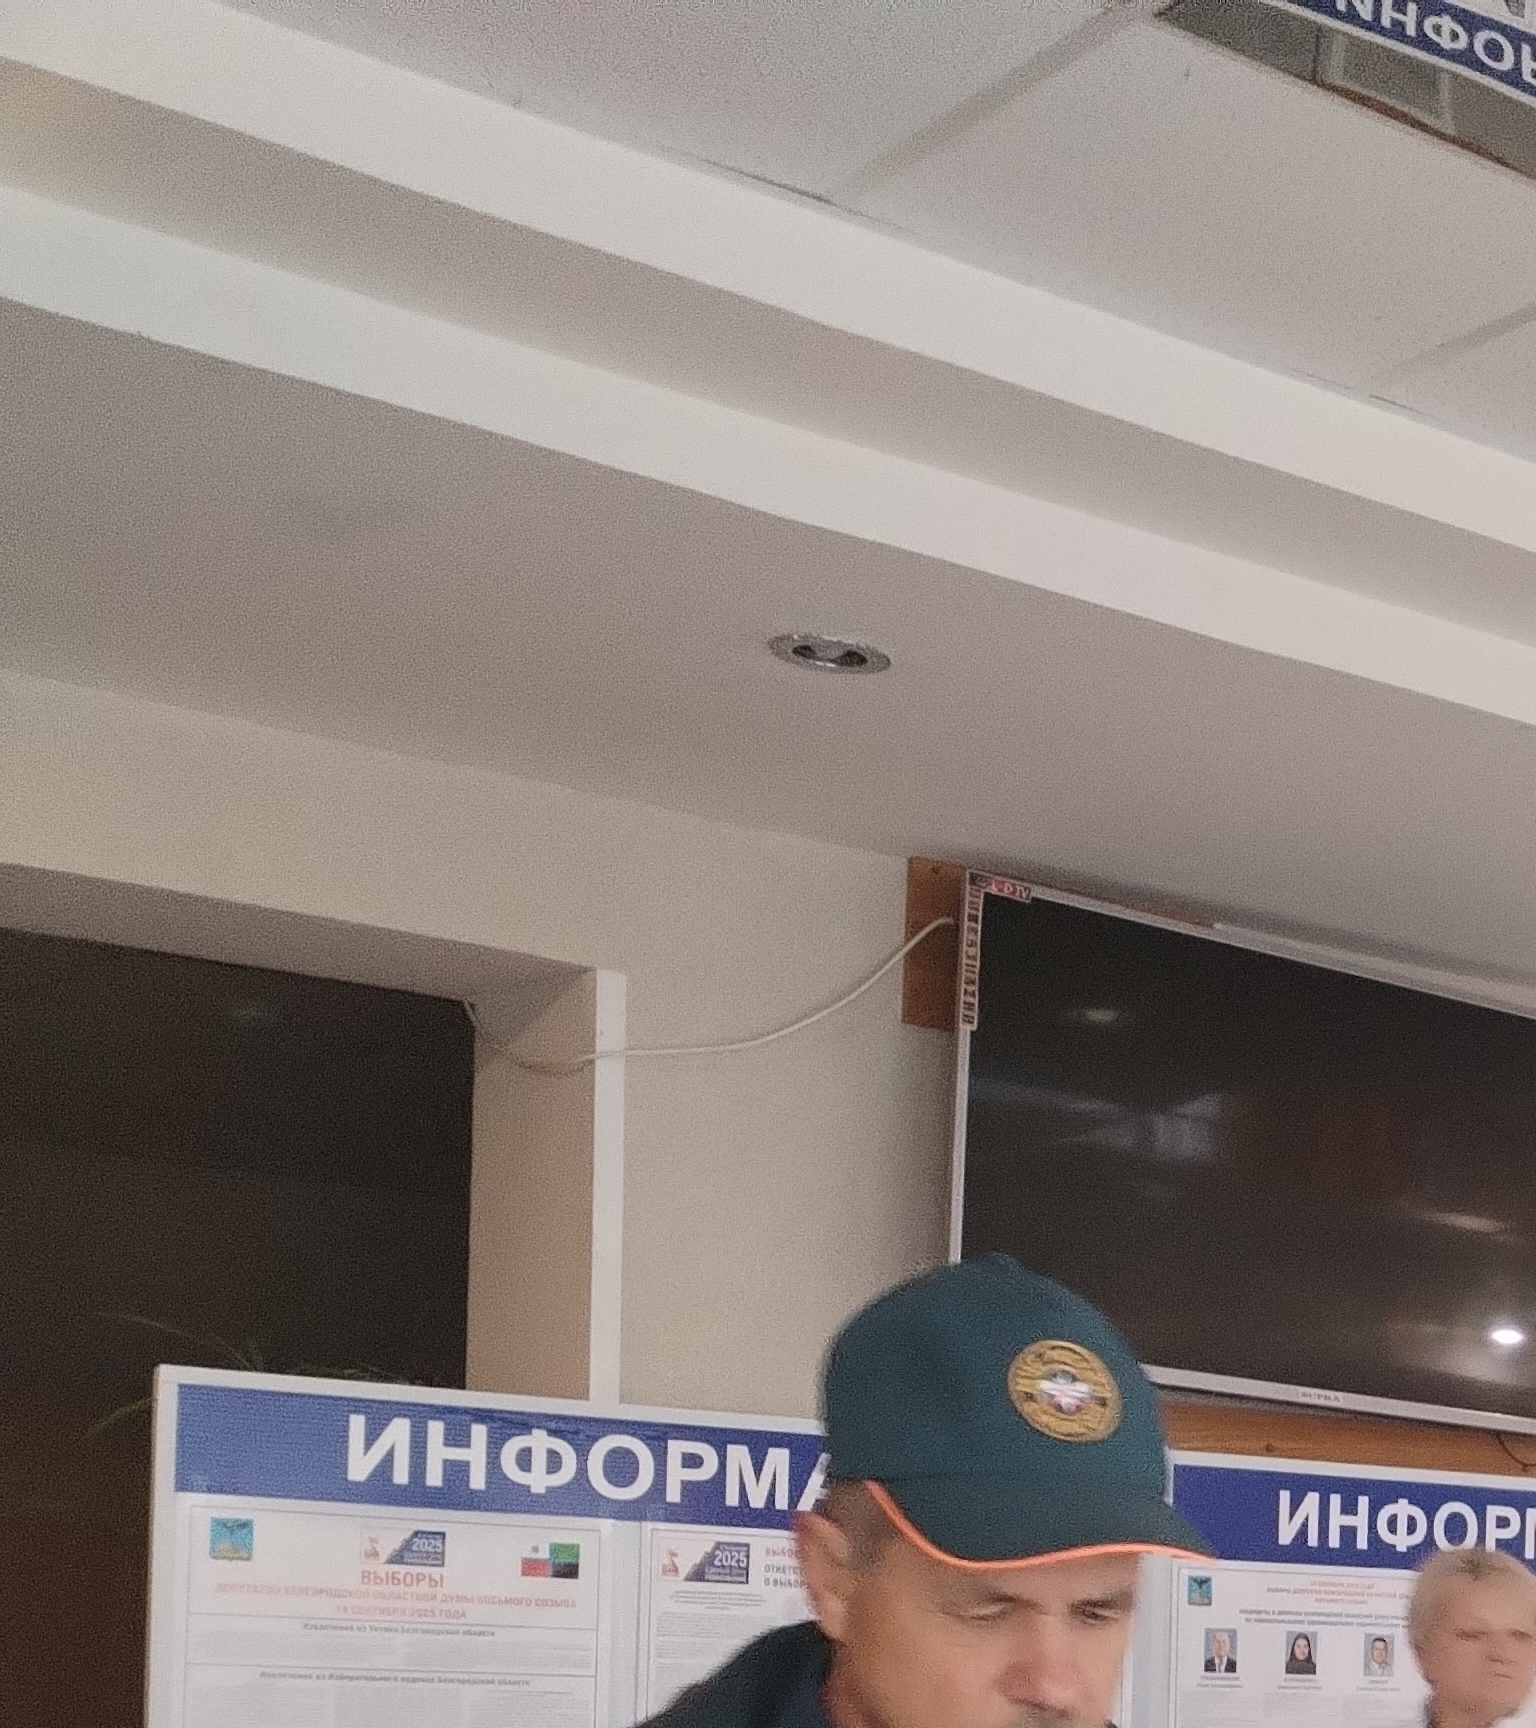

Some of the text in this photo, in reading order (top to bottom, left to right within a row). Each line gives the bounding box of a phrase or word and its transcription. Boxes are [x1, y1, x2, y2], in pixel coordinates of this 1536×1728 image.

[347, 1414, 830, 1511] ИНФОРМ
[713, 1550, 747, 1567] 2025
[361, 1570, 443, 1588] ВЫБОРЫ
